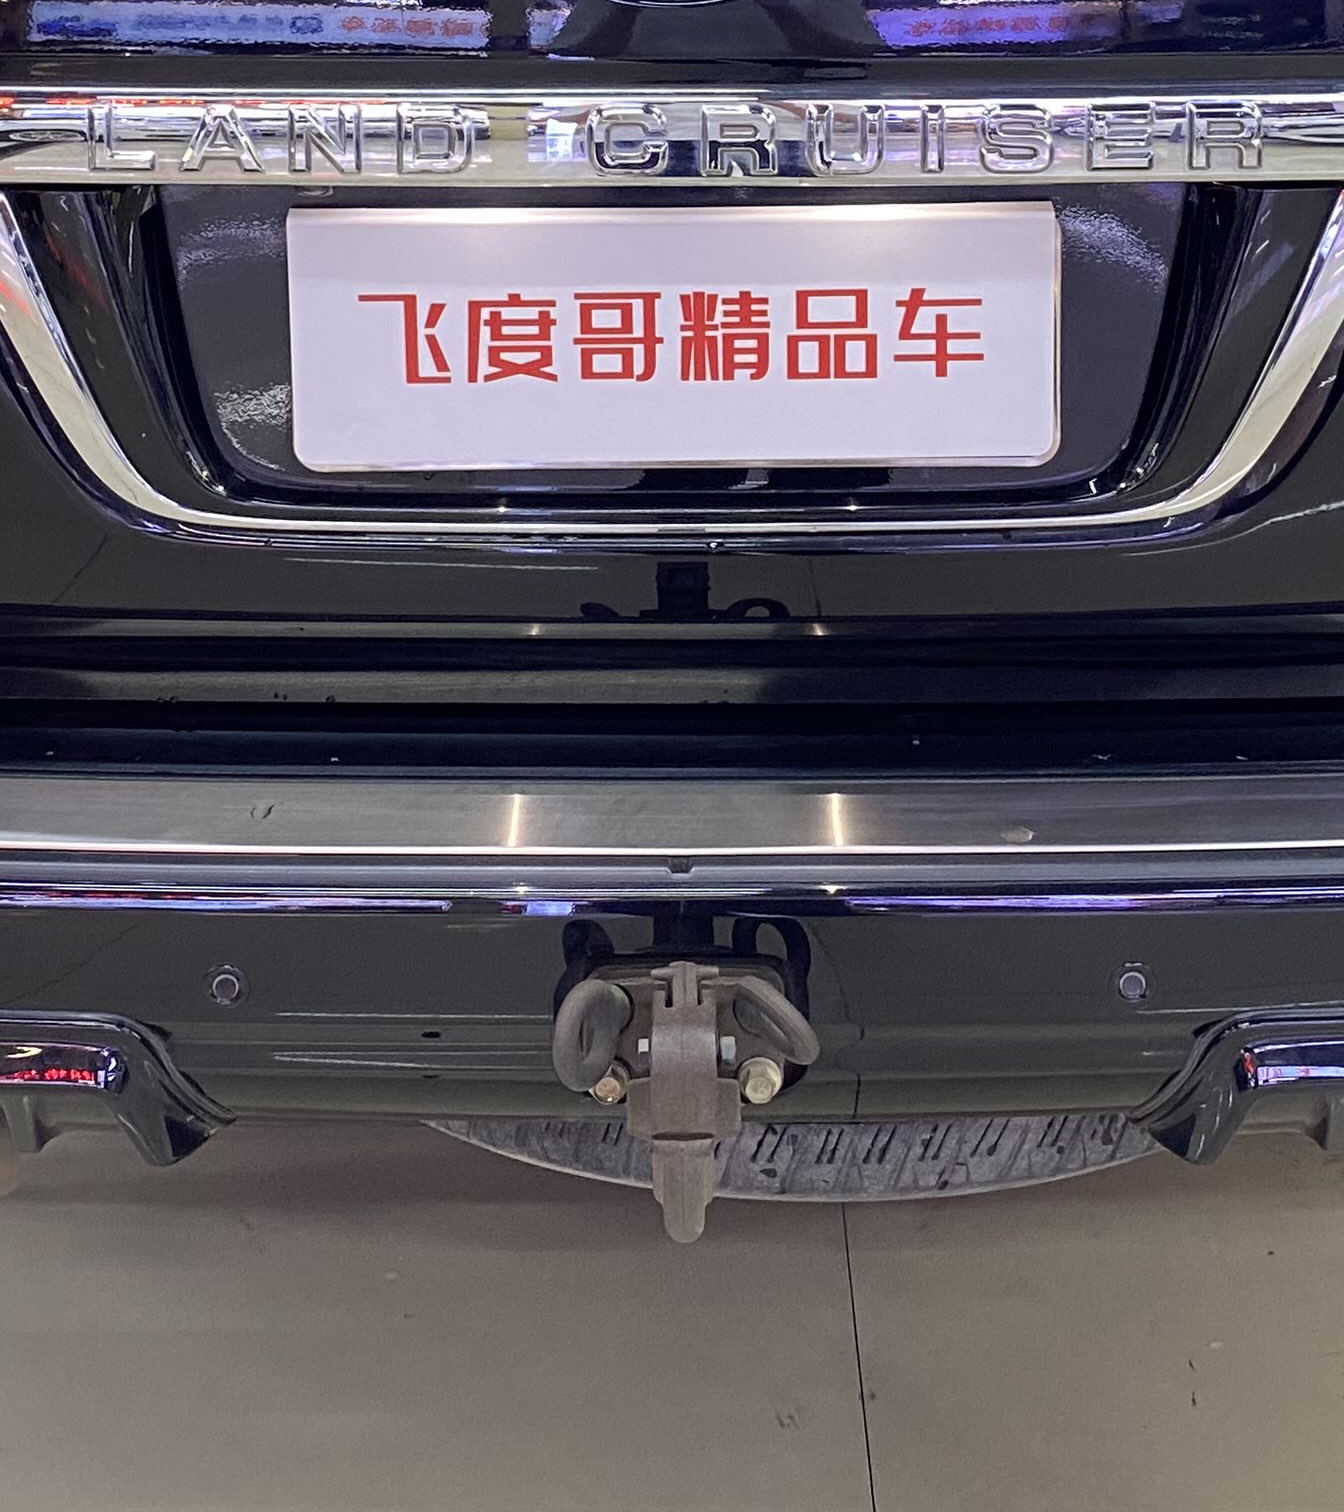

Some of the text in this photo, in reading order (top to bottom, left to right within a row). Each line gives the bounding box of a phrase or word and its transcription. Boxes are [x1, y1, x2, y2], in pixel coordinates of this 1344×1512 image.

[85, 100, 1266, 178] LAND CRUISER
[358, 288, 984, 384] 飞度哥精品车
